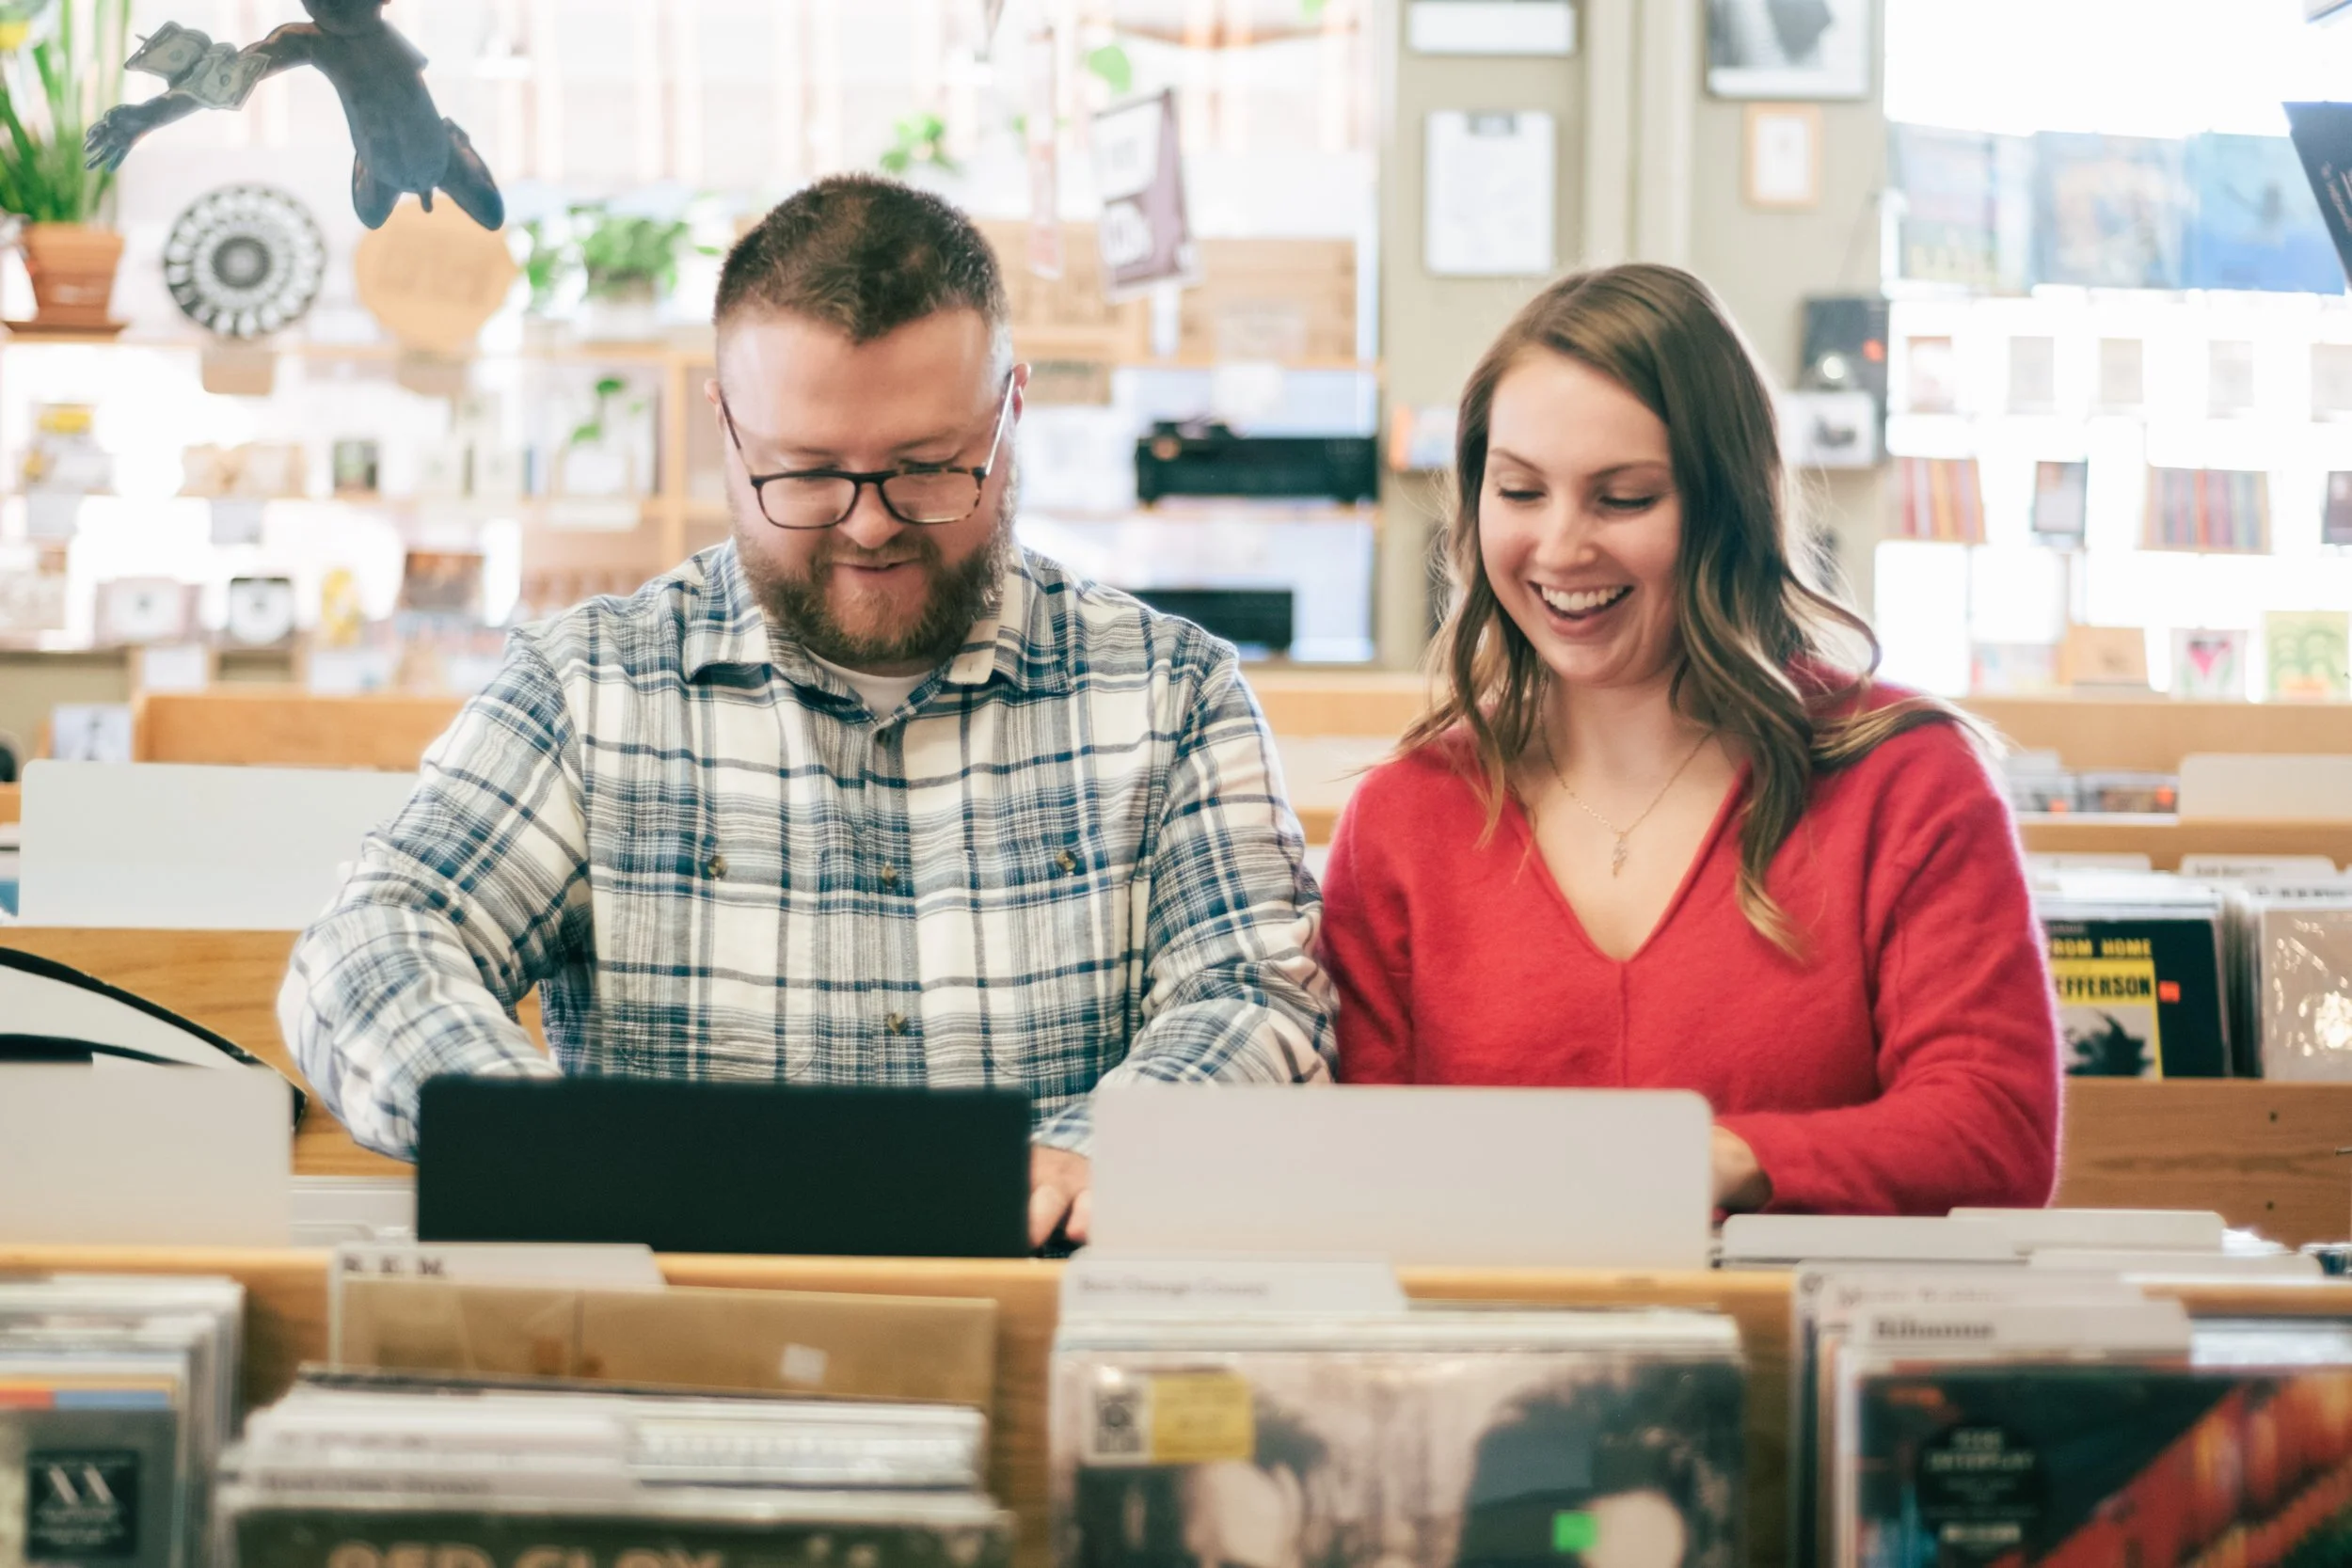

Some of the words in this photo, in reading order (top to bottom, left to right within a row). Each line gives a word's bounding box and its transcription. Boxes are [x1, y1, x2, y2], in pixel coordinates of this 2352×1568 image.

[2051, 938, 2092, 958] ROM
[2101, 938, 2152, 958] HOME
[2055, 976, 2152, 997] EFFERSON
